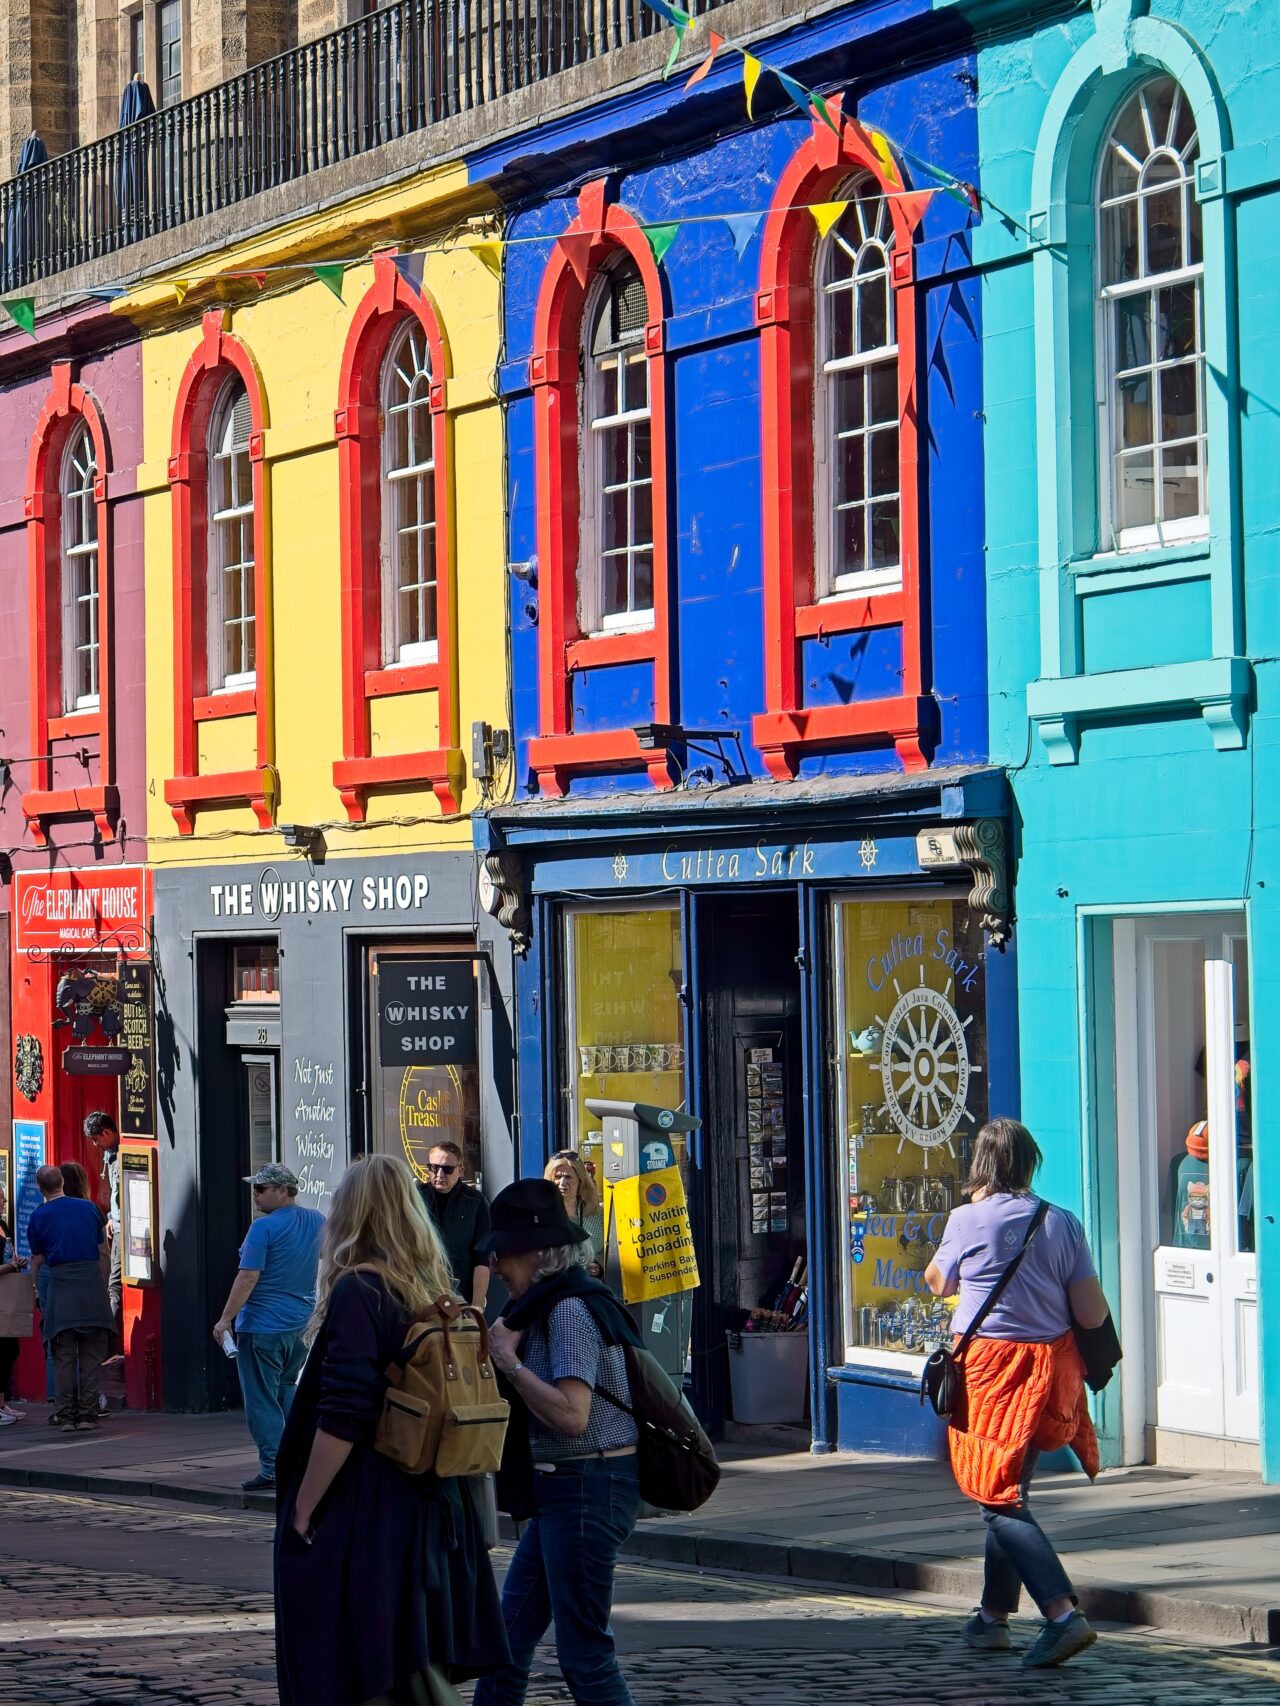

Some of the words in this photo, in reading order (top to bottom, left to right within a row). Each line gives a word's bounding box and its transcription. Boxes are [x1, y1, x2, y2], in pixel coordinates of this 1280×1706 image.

[662, 843, 740, 881] Cuttea
[756, 837, 816, 878] Sark
[22, 884, 48, 925] The
[46, 887, 100, 920] ELEPHANT
[102, 887, 137, 919] HOUSE
[211, 885, 253, 916] THE
[261, 879, 355, 915] WHISKY
[363, 875, 430, 910] SHOP
[59, 928, 81, 939] MAGICAL
[867, 931, 924, 992] Cuttea
[933, 928, 980, 993] Sark
[407, 976, 447, 990] THE
[123, 1003, 147, 1018] BUTTER
[387, 1005, 469, 1022] WHISKY
[123, 1019, 147, 1034] SCOTCH
[257, 1026, 268, 1044] 28
[127, 1035, 144, 1050] BEER
[401, 1036, 455, 1051] SHOP
[912, 993, 929, 1004] Java
[959, 1057, 967, 1096] Costa
[295, 1056, 313, 1085] Not
[295, 1097, 336, 1122] Another
[295, 1131, 334, 1172] Whisky
[628, 1215, 645, 1230] No
[649, 1206, 689, 1224] Waitin
[631, 1223, 681, 1245] Loading
[643, 1258, 677, 1275] Parking
